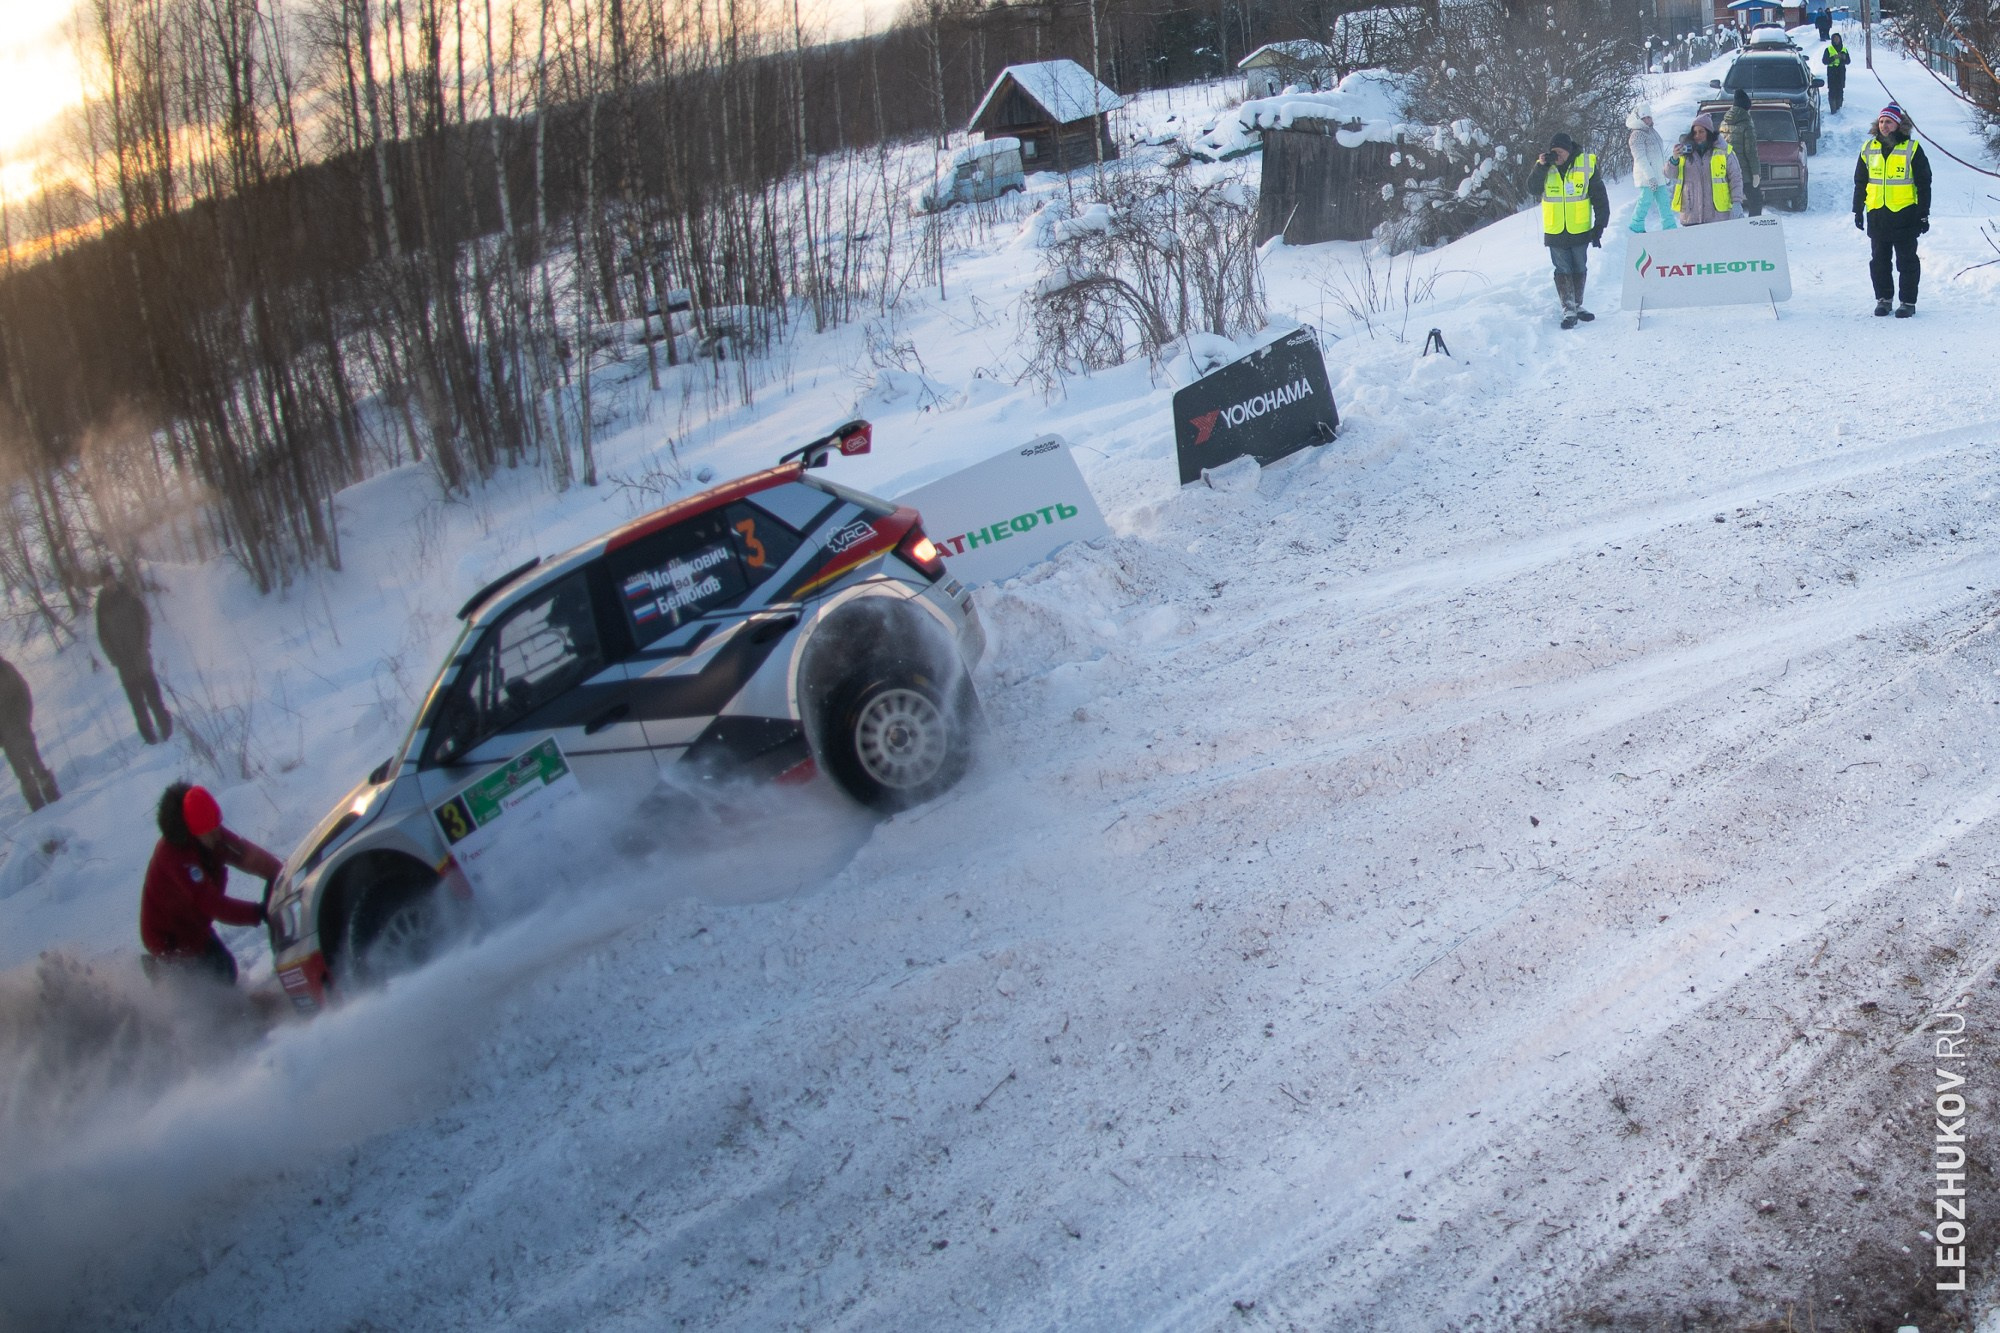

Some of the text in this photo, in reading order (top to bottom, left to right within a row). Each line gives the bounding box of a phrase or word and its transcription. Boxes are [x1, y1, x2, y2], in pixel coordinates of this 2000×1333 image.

[1656, 260, 1775, 277] ТАТНЕФТЬ
[1221, 378, 1313, 428] YOKOHAMA
[736, 519, 766, 567] 3
[833, 525, 867, 545] VRC
[934, 502, 1078, 558] АТНЕФТЬ
[648, 547, 729, 590] Мокович
[443, 803, 467, 838] 3
